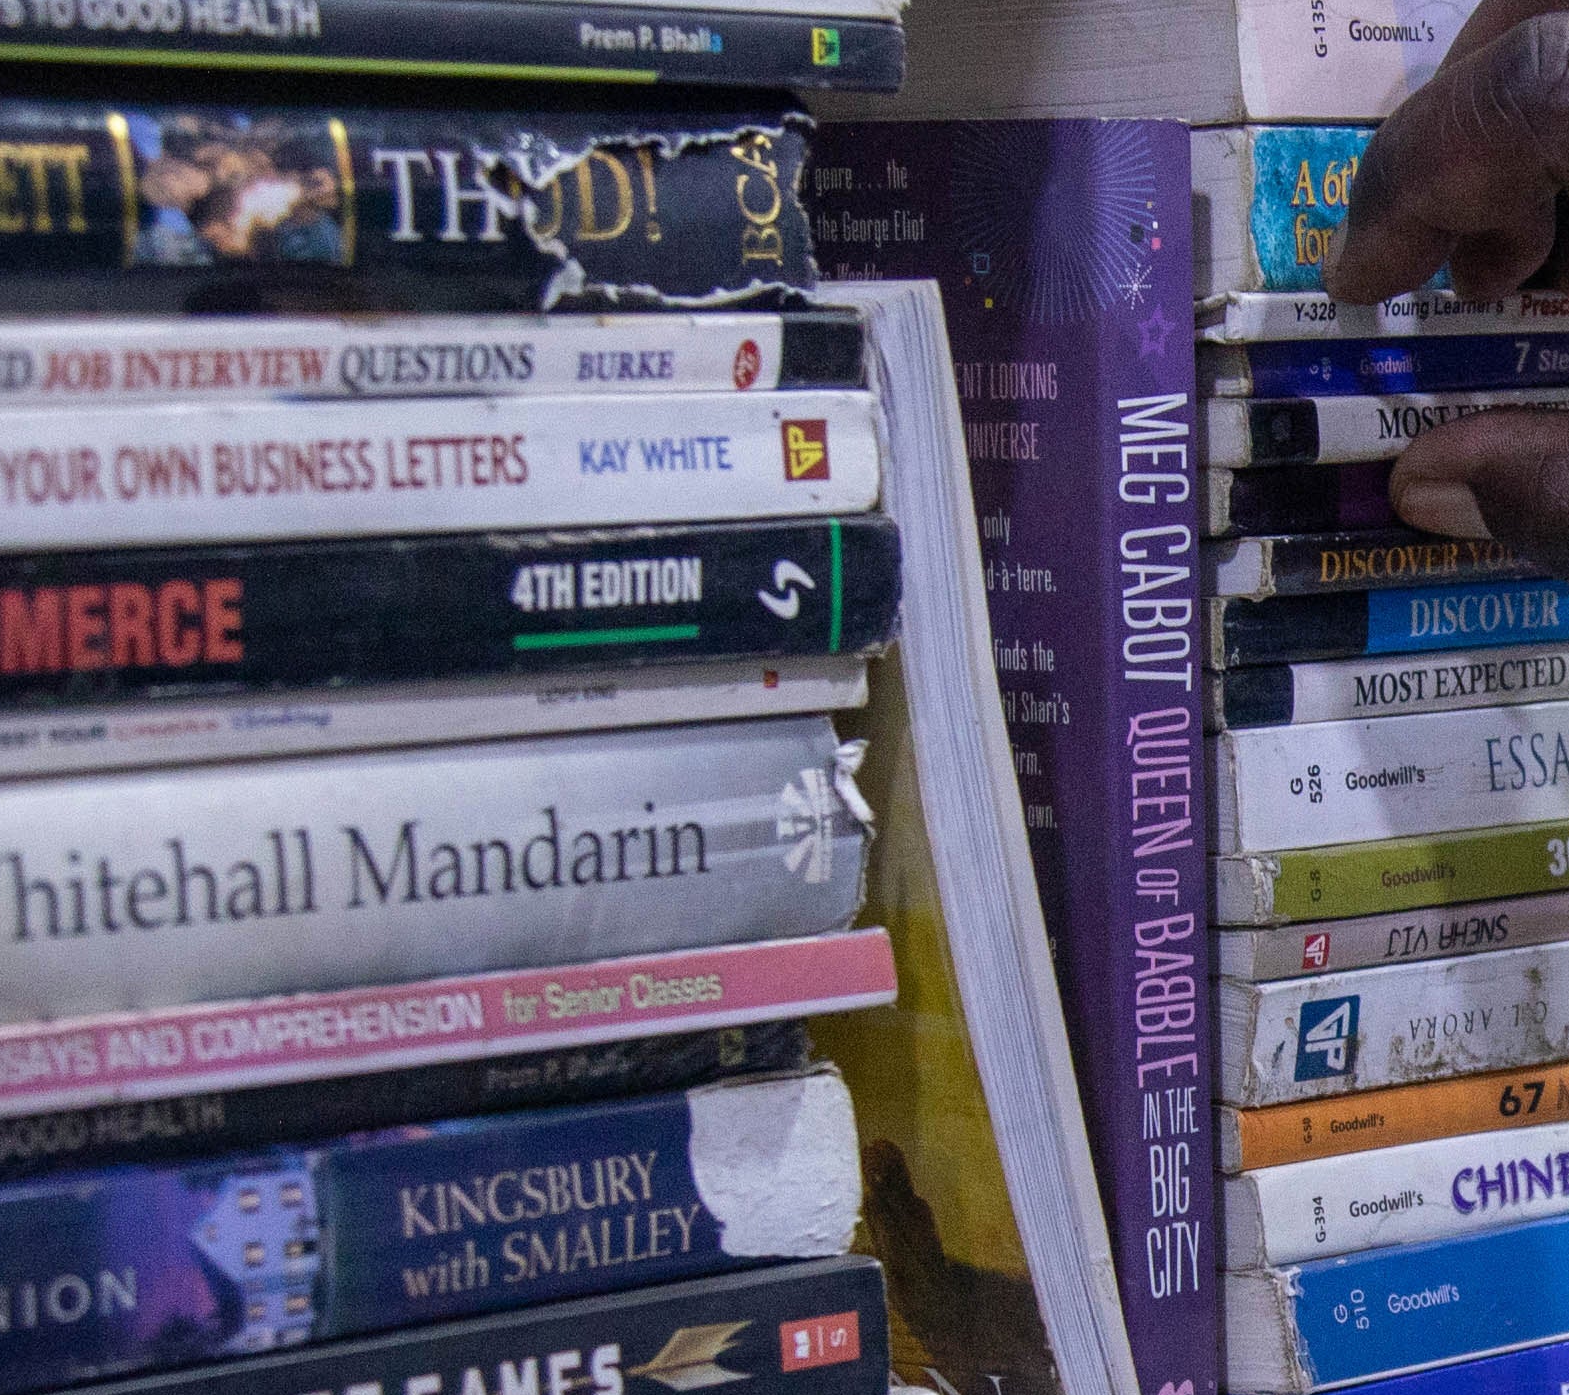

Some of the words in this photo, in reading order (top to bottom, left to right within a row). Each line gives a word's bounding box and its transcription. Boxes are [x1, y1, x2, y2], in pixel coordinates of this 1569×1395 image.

[841, 214, 887, 246] George
[893, 209, 926, 243] Eliot
[1295, 302, 1336, 322] Y-328
[339, 342, 536, 391] QUESTIONS
[577, 351, 675, 384] BURKE
[1117, 392, 1189, 504] MEG
[510, 567, 575, 611] 4TH
[583, 557, 702, 605] EDITION
[1119, 525, 1194, 693] CABOT
[1354, 670, 1428, 706] MOST
[1434, 656, 1566, 697] EXPECTED
[1126, 707, 1193, 857] QUEEN
[1345, 766, 1426, 790] Goodwill's
[343, 803, 710, 910] Mandarin
[1136, 867, 1179, 907] OF
[1384, 928, 1429, 958] VIJ
[1439, 915, 1509, 946] SNEHA
[1135, 911, 1198, 1088] BABBLE
[1142, 1090, 1162, 1139] IN
[1165, 1087, 1199, 1136] THE
[1499, 1083, 1545, 1117] 67
[399, 1151, 657, 1240] KINGSBURY
[1148, 1144, 1190, 1218] BIG
[1349, 1191, 1424, 1217] Goodwill's
[400, 1243, 489, 1299] with
[503, 1204, 701, 1285] SMALLEY
[1145, 1221, 1200, 1299] CITY
[1388, 1283, 1460, 1313] Goodwill's
